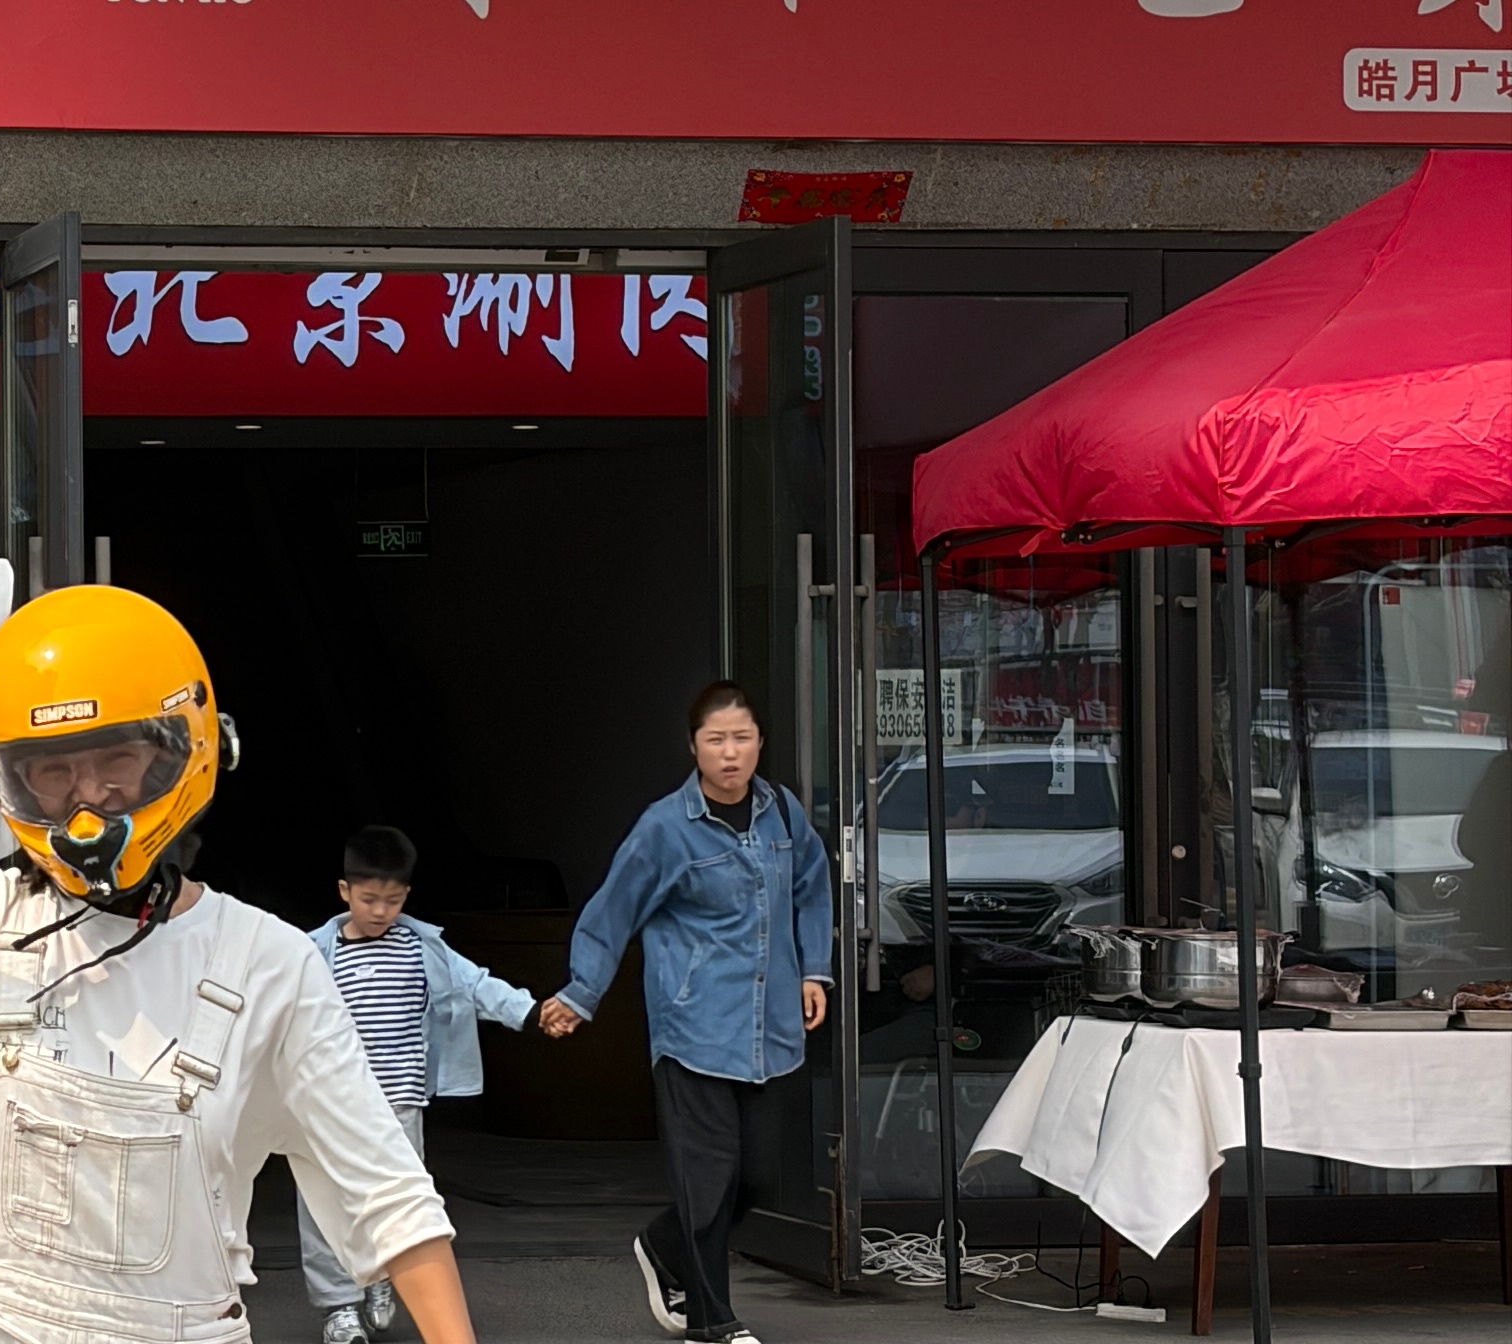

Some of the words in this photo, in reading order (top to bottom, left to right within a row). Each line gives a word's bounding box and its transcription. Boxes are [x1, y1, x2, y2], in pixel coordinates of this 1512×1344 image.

[879, 677, 956, 711] 聘保安洁
[33, 702, 94, 725] SIMPSON
